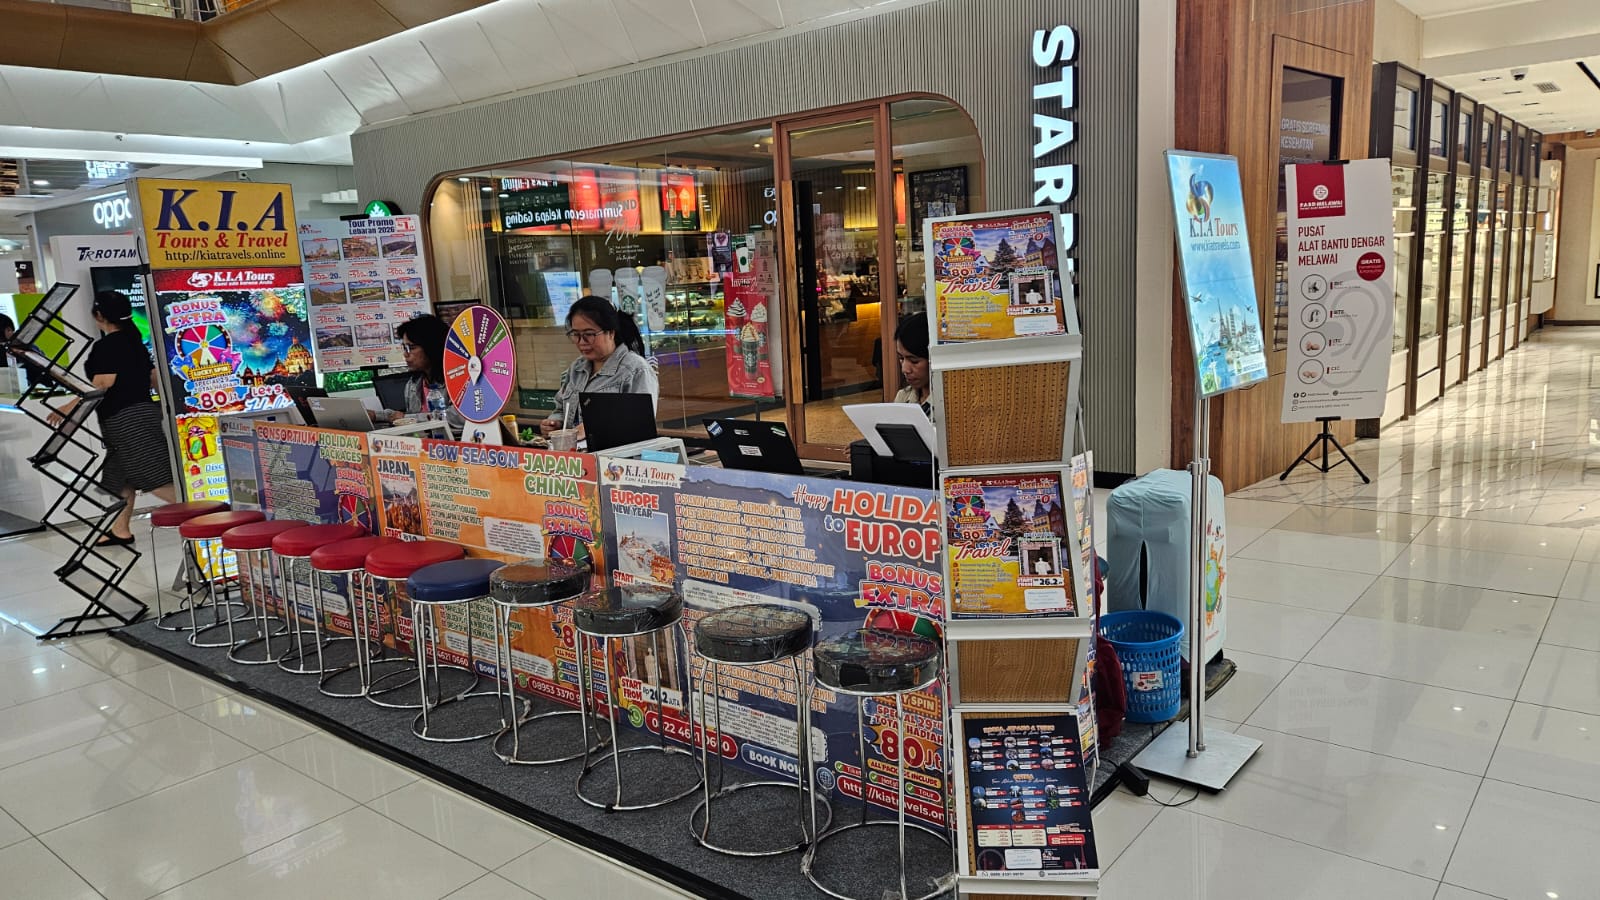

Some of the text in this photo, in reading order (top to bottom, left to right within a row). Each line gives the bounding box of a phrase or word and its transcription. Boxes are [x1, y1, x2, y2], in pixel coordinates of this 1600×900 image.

[153, 188, 288, 231] K.I.A
[378, 225, 395, 234] 2026
[1214, 218, 1239, 237] Tours
[1298, 225, 1326, 238] PUSAT
[157, 232, 288, 249] Tours & Travel
[1298, 235, 1385, 252] ALAT BANTU DENGAR
[165, 249, 286, 263] http://kiatravels.online
[1298, 253, 1338, 267] MELAWAI
[213, 270, 275, 281] K.I.A Tours
[941, 273, 1002, 294] Travel
[172, 300, 219, 315] BONUS
[170, 311, 226, 327] EXTRA
[256, 426, 360, 450] CONSORTIUM HOLIDAY
[320, 447, 363, 464] PACKAGES
[428, 444, 583, 478] LOW SEASON JAPAN
[336, 468, 365, 484] BONUS
[377, 459, 410, 475] JAPAN
[625, 465, 676, 481] K.I.A Tours
[524, 474, 580, 499] CHINA
[610, 488, 659, 511] EUROPE
[792, 484, 942, 525] Happy HOLIDA
[546, 503, 588, 521] BONUS
[613, 504, 653, 519] NEW YEAR
[543, 517, 594, 542] EXTRA
[824, 515, 943, 563] to EUROP
[954, 537, 1011, 560] Travel
[613, 570, 635, 583] START
[867, 563, 942, 594] BONUS
[860, 583, 945, 617] EXTRA
[531, 680, 576, 701] 08953 3370
[621, 676, 643, 690] START
[623, 687, 643, 701] FROM
[911, 695, 935, 711] SPIN
[652, 717, 730, 752] 022 461 060
[874, 713, 944, 745] TOTA HADIAH
[880, 728, 925, 769] 80
[748, 750, 777, 768] BOOK
[870, 761, 881, 771] ALL
[911, 774, 938, 787] INCLUDE
[918, 788, 935, 799] Tour
